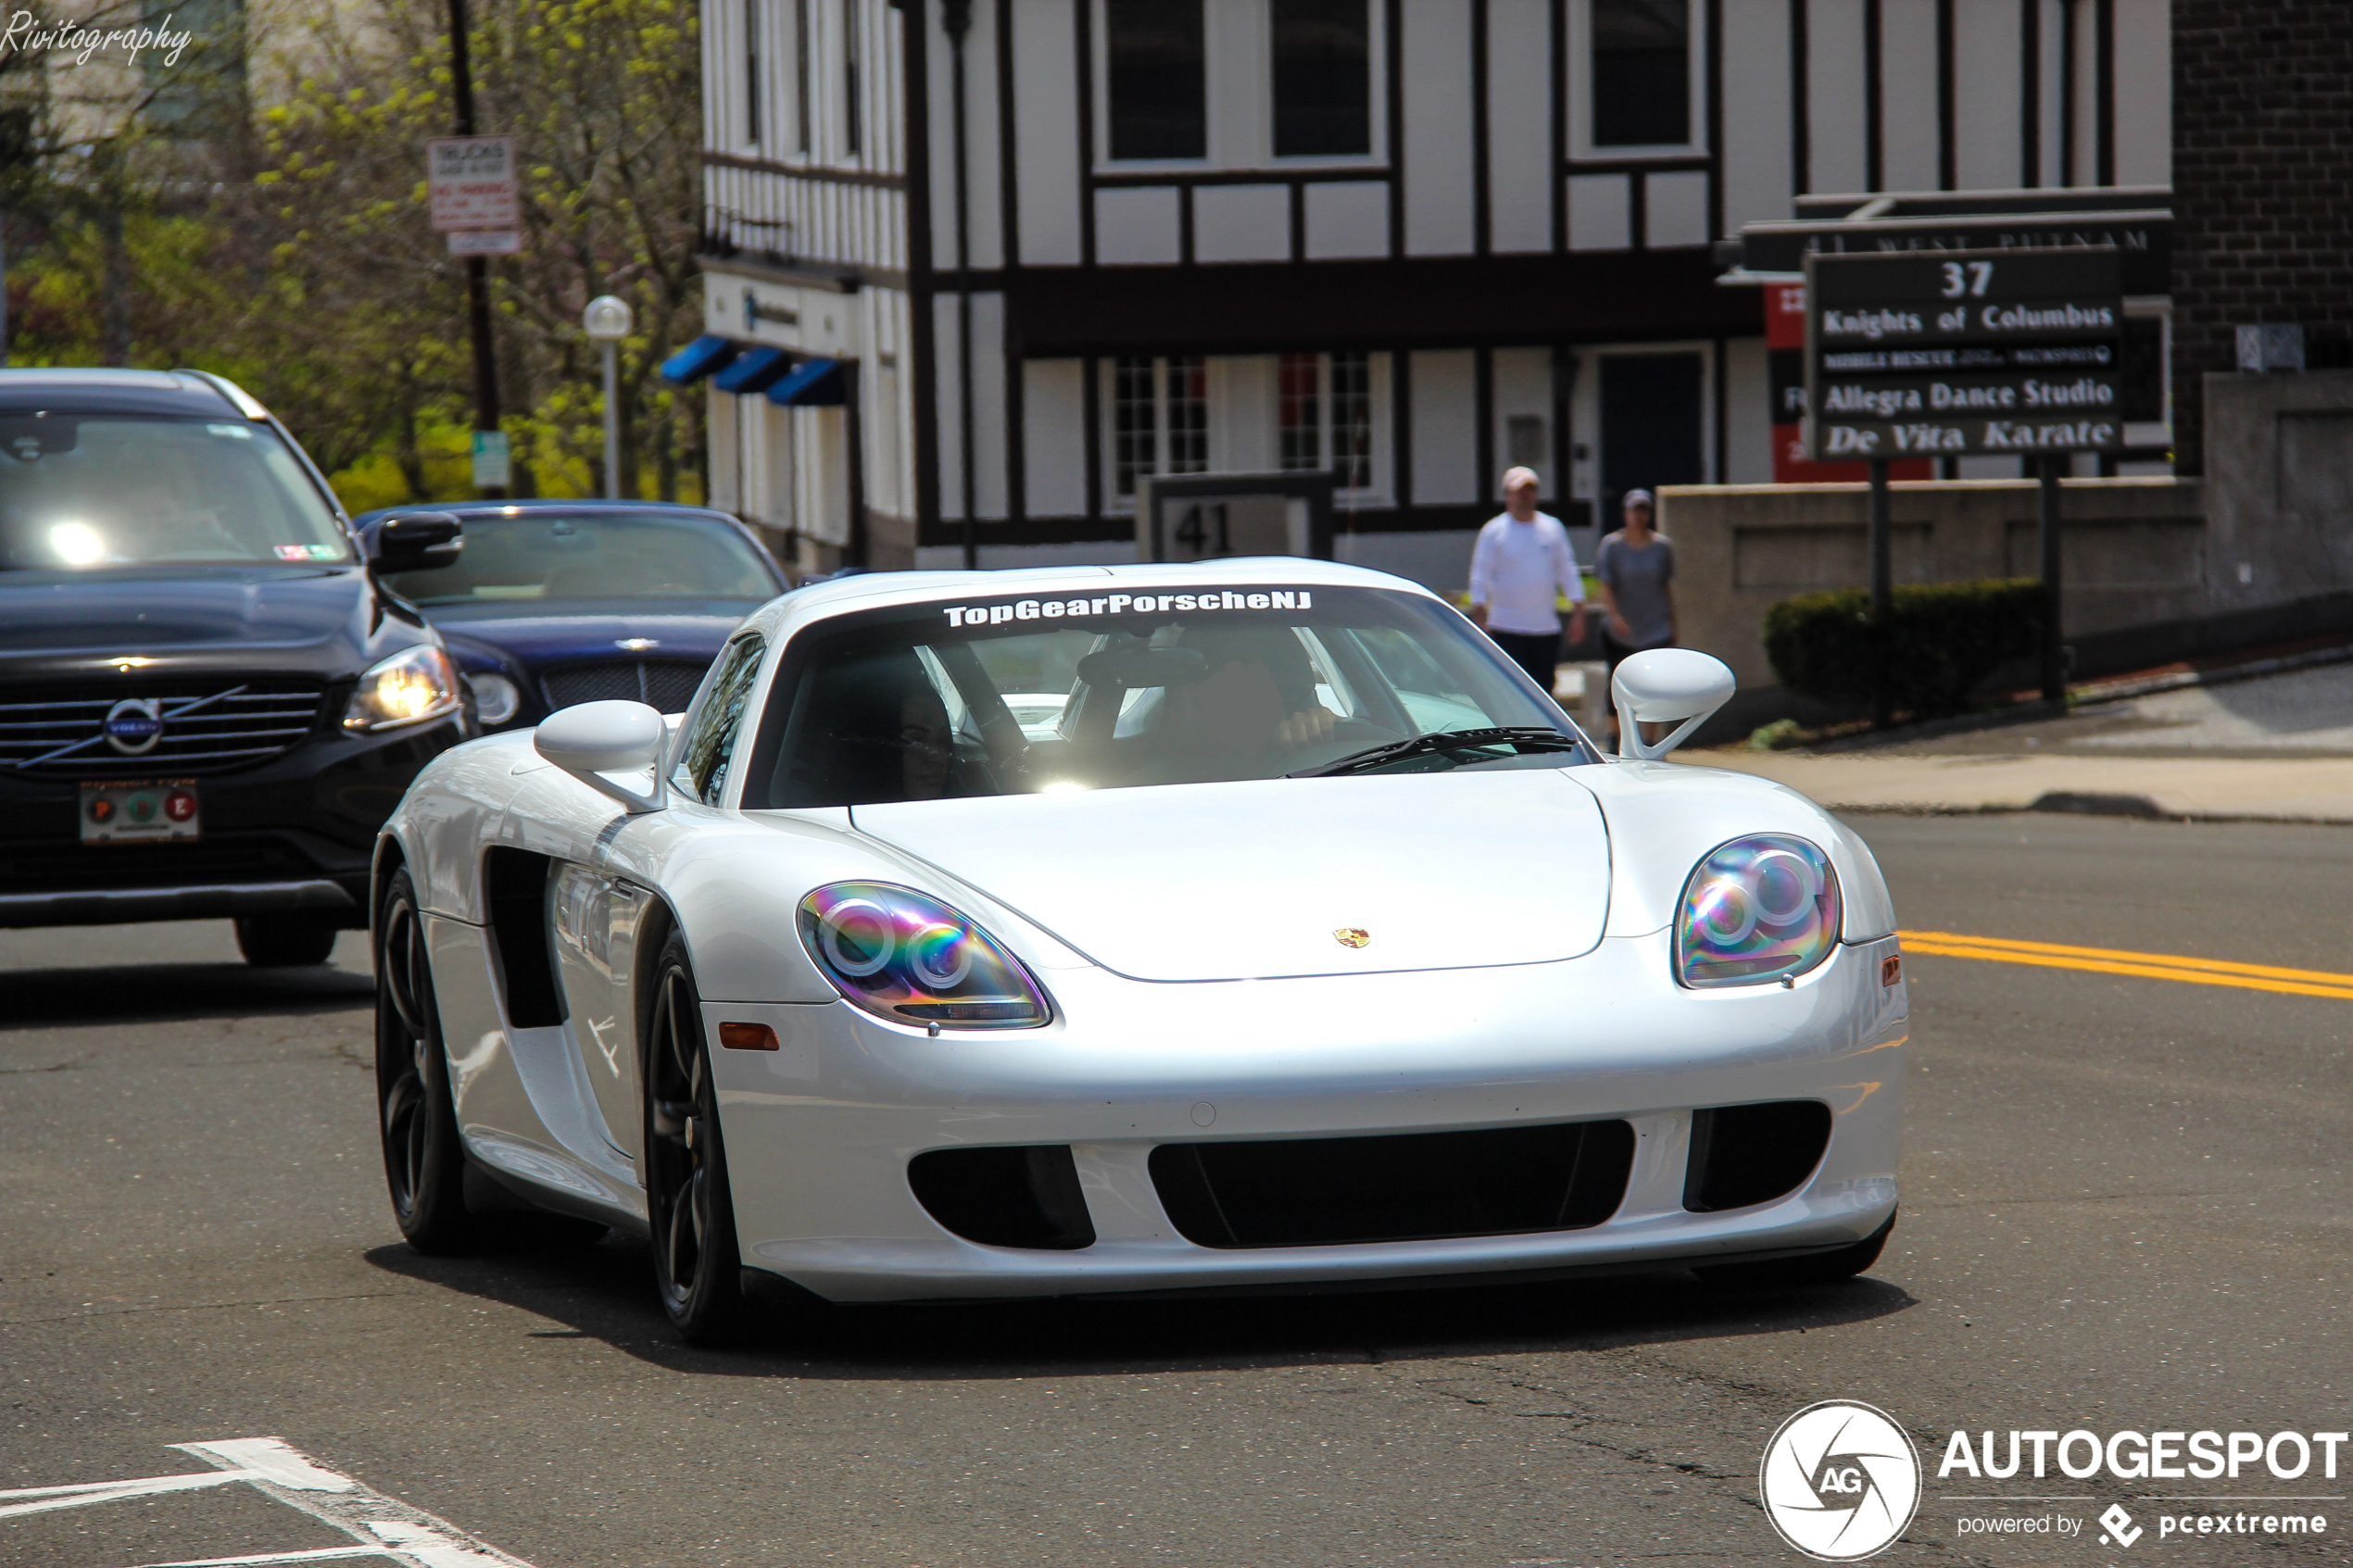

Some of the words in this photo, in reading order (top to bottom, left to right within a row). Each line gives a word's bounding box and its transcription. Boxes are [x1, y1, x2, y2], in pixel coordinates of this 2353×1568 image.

[1942, 260, 1994, 297] 37
[1823, 309, 1923, 341] Knights
[1937, 307, 1967, 330] of
[1982, 304, 2113, 330] Columbus
[1824, 385, 1922, 417] Allegra
[1930, 382, 2017, 408] Dance
[2023, 378, 2114, 406] Studio
[1825, 425, 1880, 455] De
[1893, 422, 1966, 451] Vita
[1983, 419, 2114, 448] Karate
[1175, 502, 1232, 555] 41
[943, 590, 1313, 627] TopGearPorscheNJ
